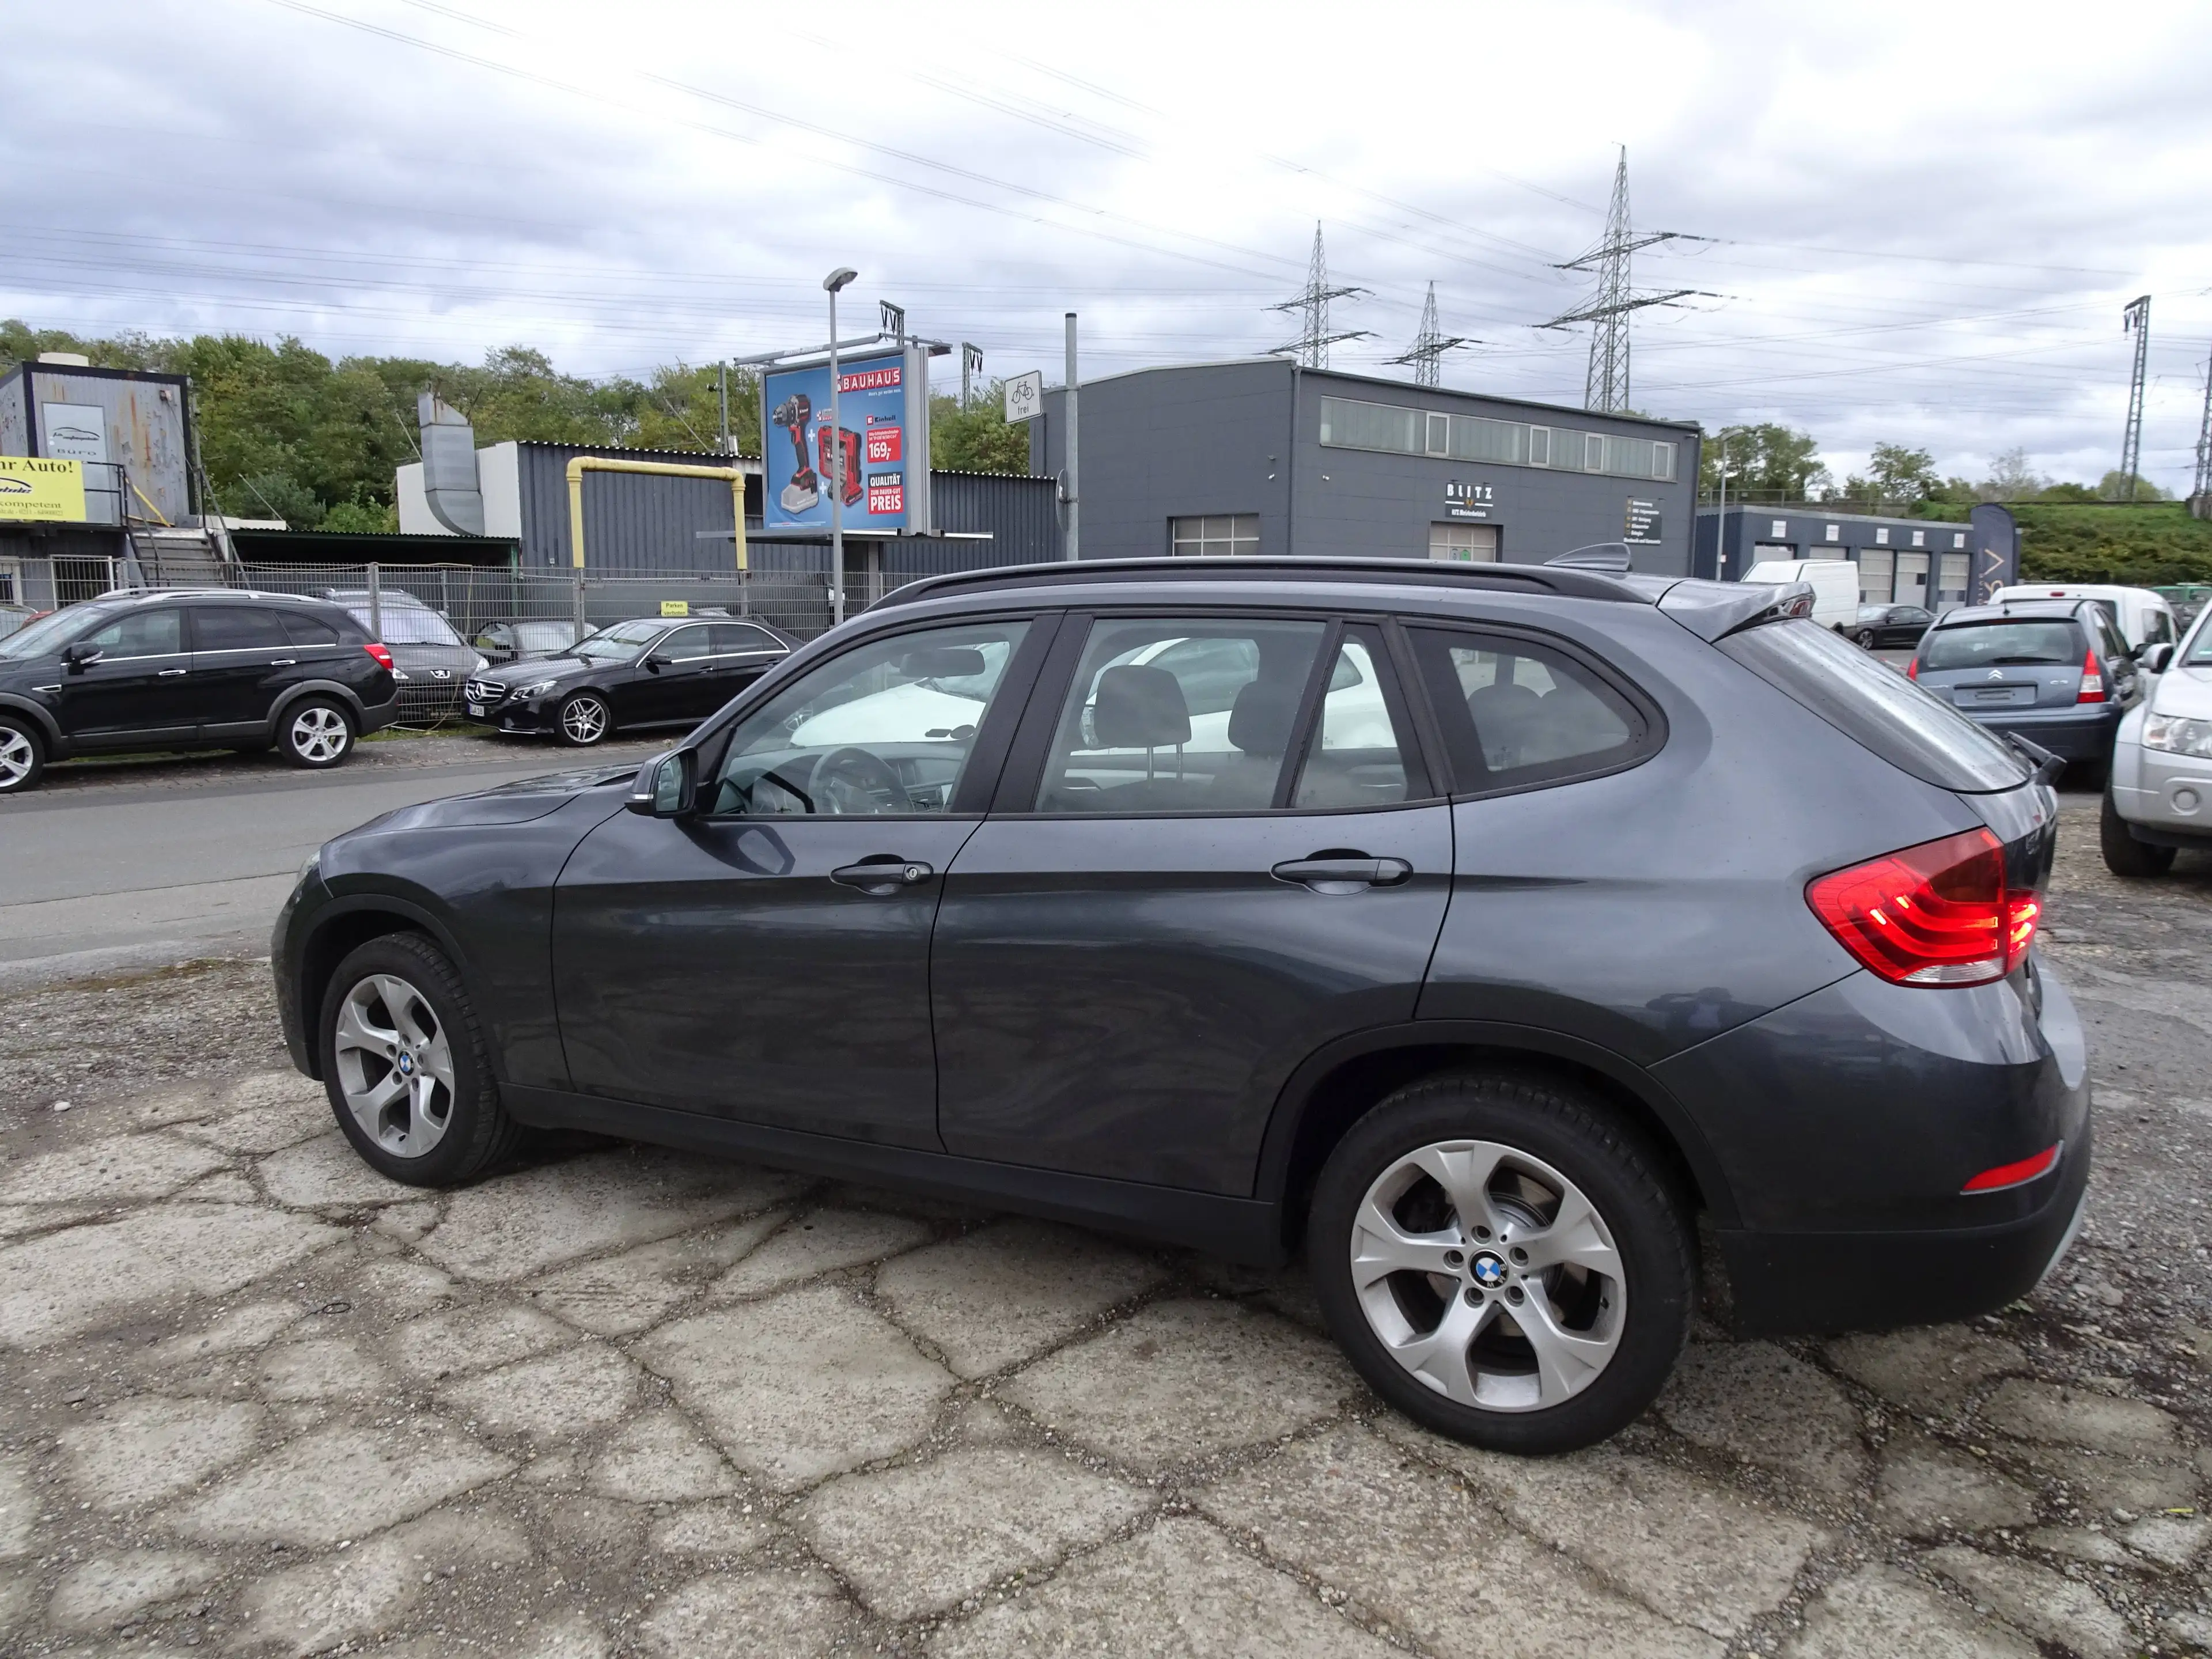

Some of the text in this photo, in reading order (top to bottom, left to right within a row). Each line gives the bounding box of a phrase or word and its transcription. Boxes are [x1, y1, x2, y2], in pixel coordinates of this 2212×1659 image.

[843, 369, 900, 390] BAUHAUS
[1018, 403, 1029, 415] frei
[869, 442, 891, 460] 169,-
[22, 459, 73, 473] Auto!
[870, 474, 900, 487] QUALITÄT
[1447, 483, 1492, 499] BLITZ
[870, 495, 901, 512] PREIS
[1486, 1263, 1507, 1289] BMW
